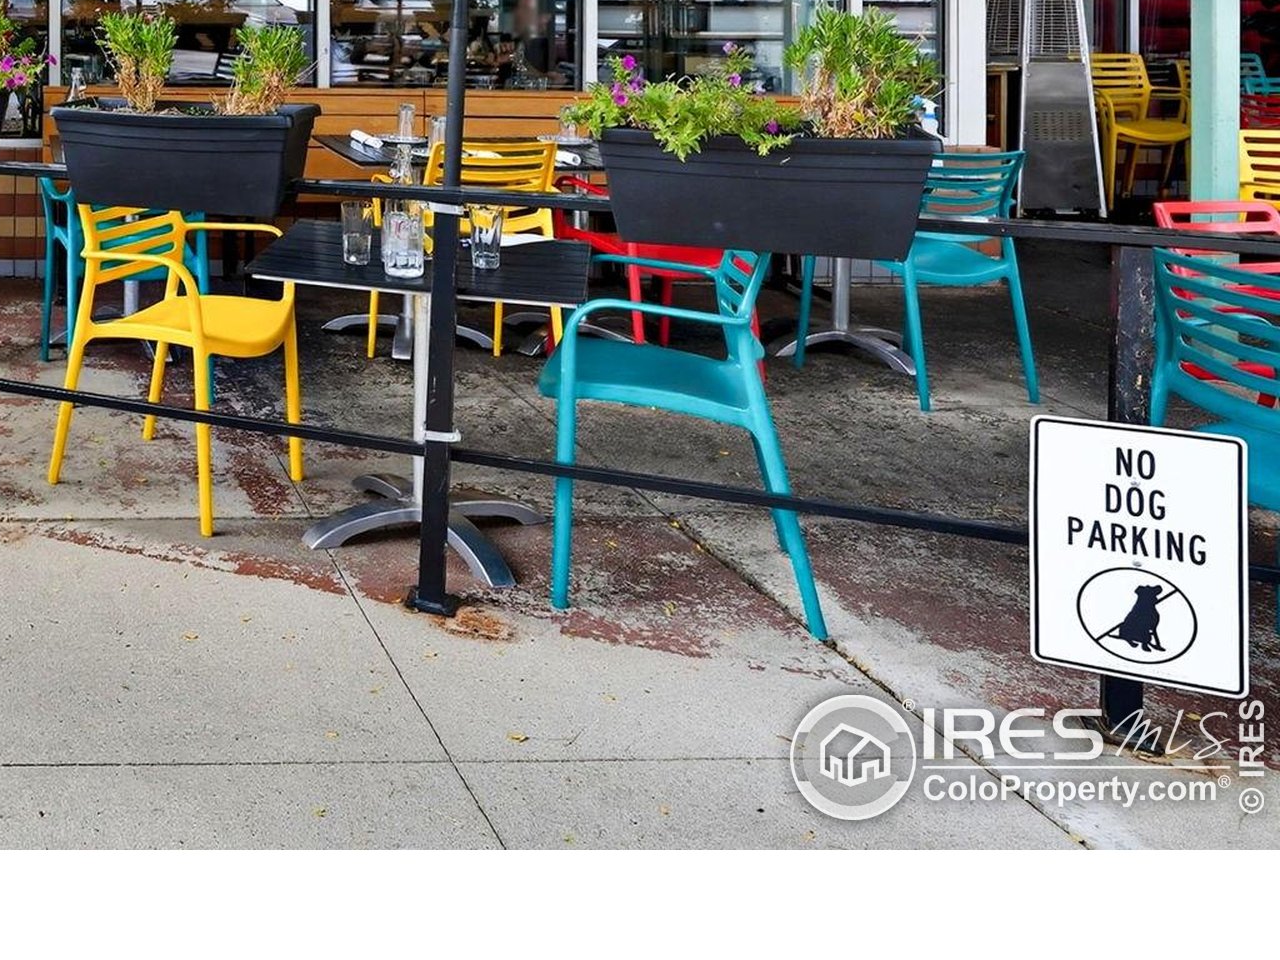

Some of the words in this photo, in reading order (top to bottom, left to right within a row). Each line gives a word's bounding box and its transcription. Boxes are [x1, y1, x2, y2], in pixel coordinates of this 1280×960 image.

[1116, 446, 1156, 480] NO
[1105, 483, 1166, 521] DOG
[1067, 516, 1207, 566] PARKING
